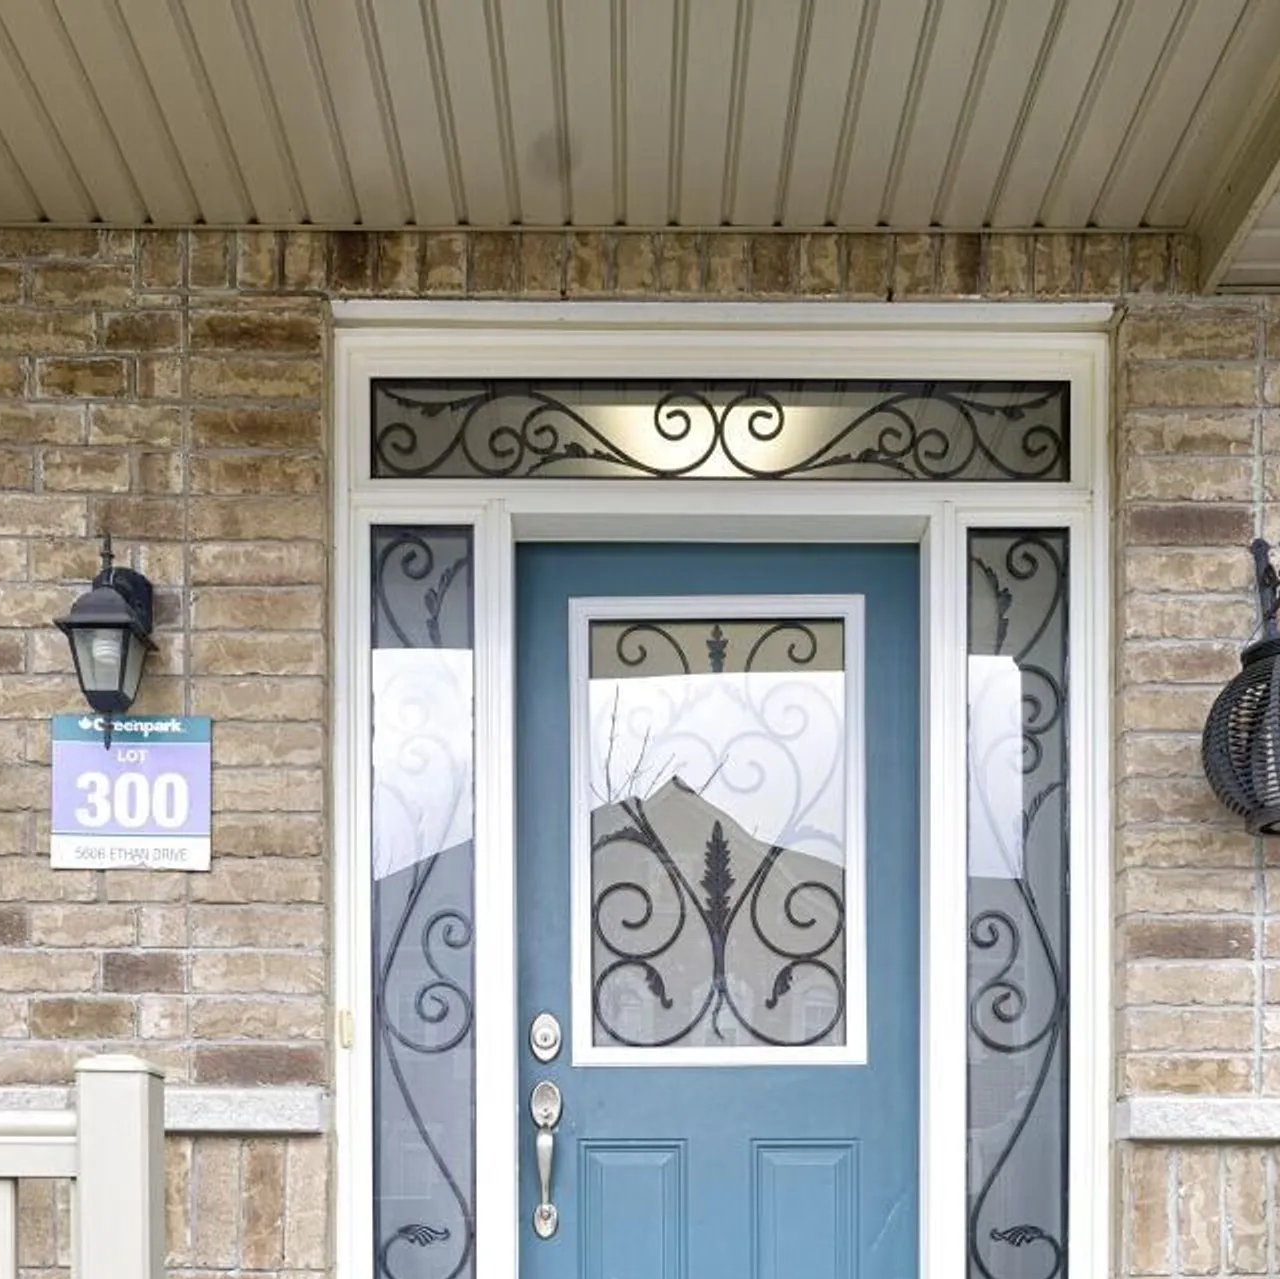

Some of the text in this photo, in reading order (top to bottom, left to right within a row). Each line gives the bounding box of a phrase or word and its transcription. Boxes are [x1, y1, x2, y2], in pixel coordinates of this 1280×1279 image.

[94, 717, 182, 738] Geenpark
[117, 750, 149, 764] LOT
[75, 771, 189, 830] 300
[110, 846, 150, 862] ETHAN
[152, 847, 189, 863] DRIVE
